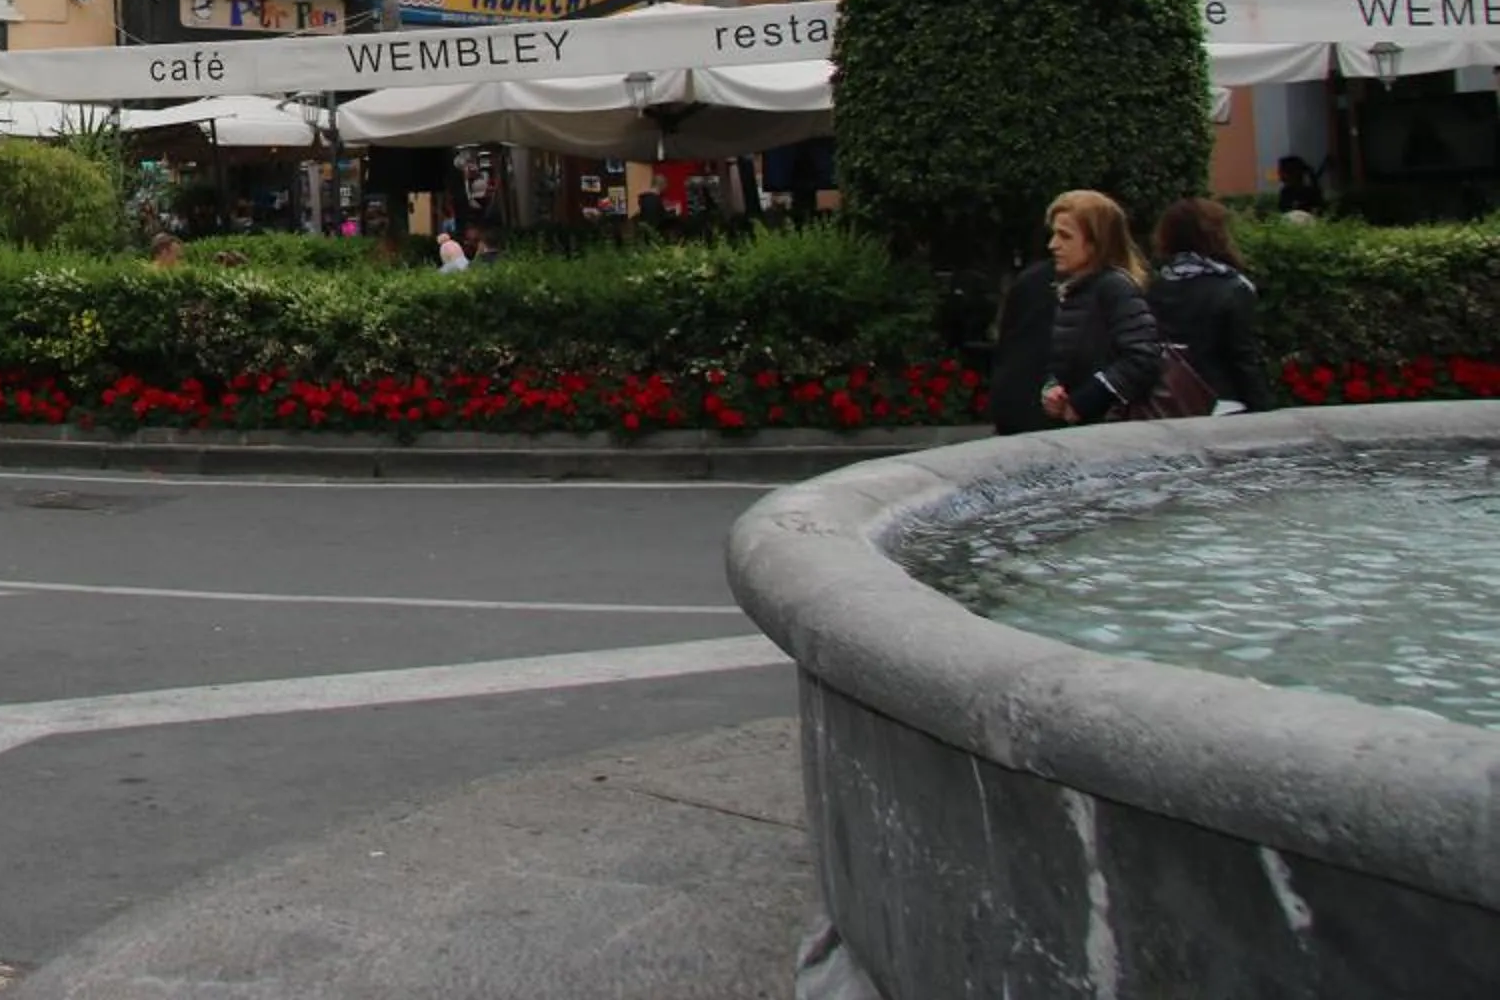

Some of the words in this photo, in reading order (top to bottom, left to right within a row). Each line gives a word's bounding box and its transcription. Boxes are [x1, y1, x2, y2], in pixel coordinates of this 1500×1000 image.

[715, 14, 829, 50] resta
[150, 51, 224, 82] café
[348, 29, 569, 74] WEMBLEY
